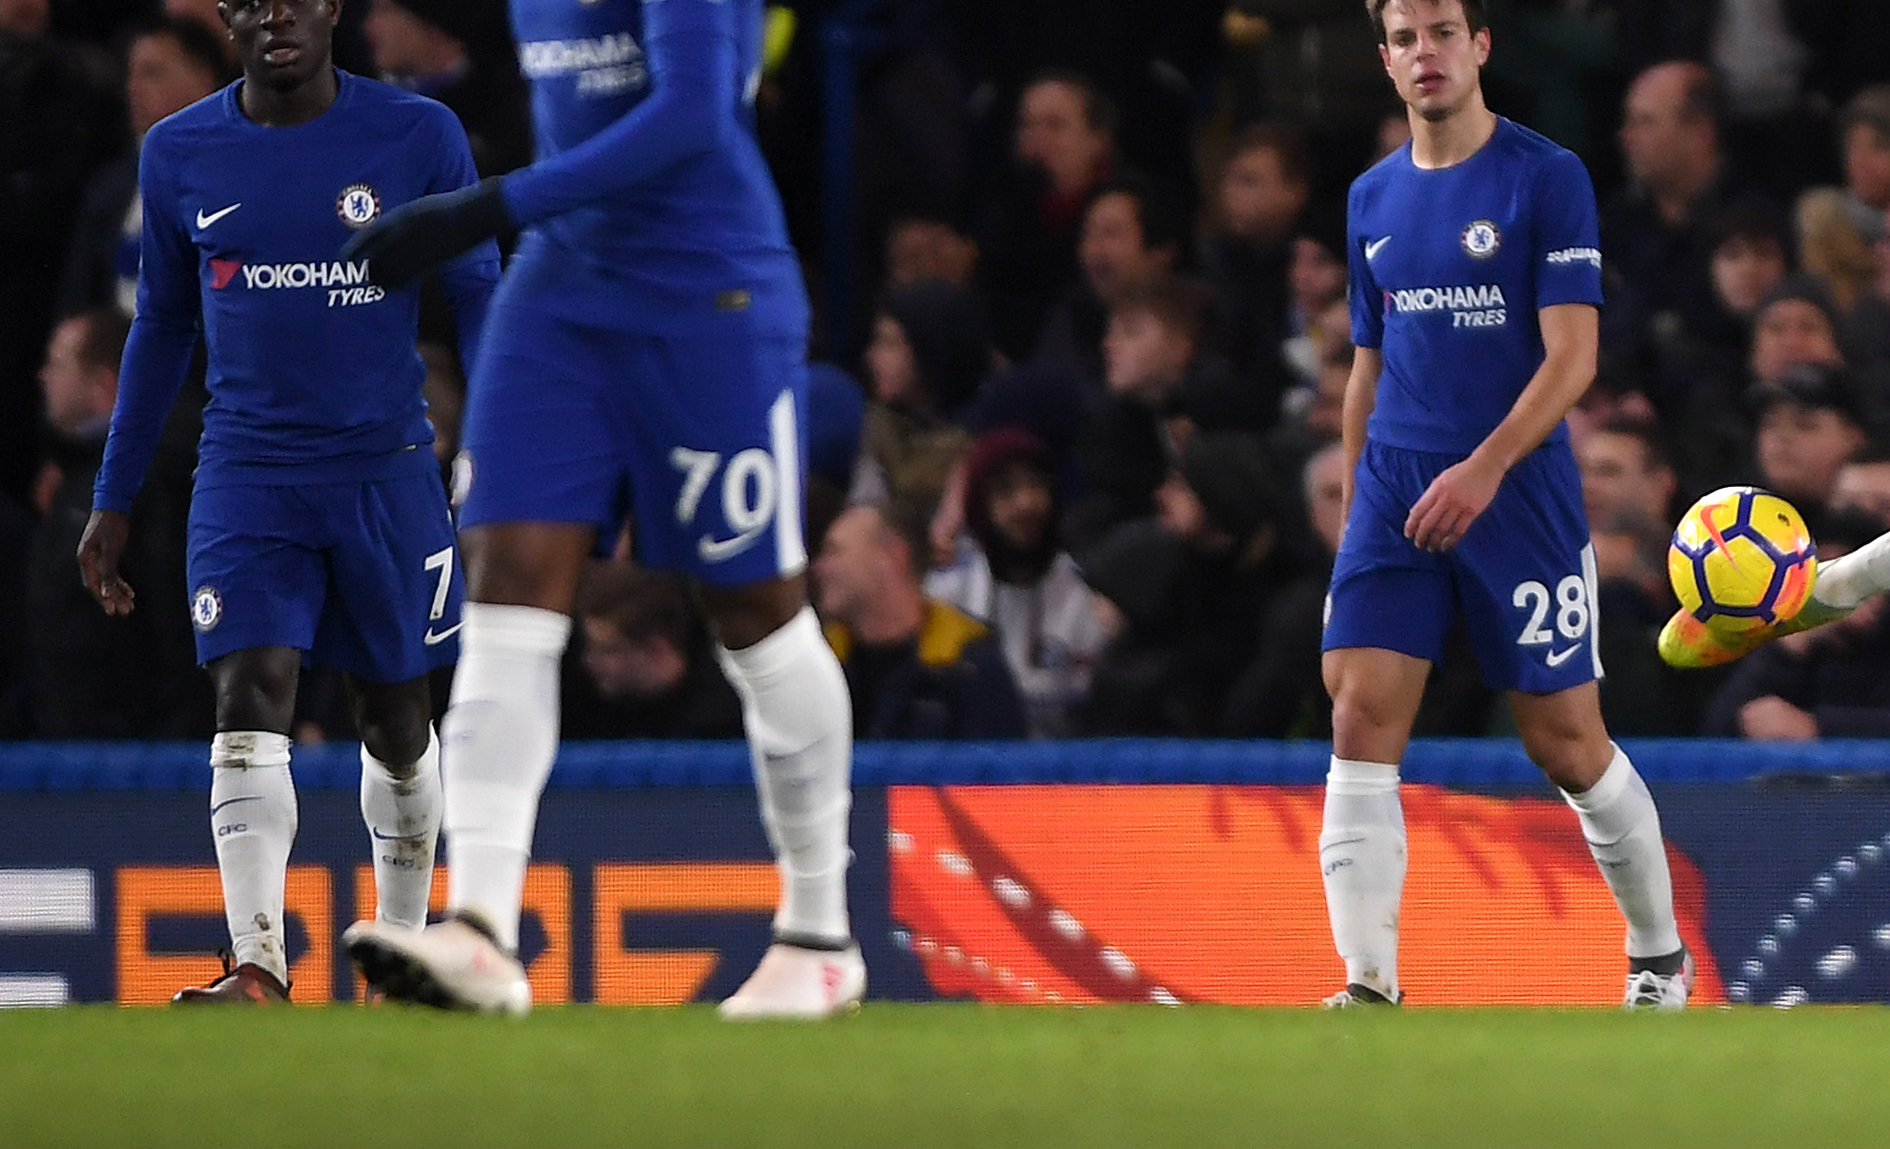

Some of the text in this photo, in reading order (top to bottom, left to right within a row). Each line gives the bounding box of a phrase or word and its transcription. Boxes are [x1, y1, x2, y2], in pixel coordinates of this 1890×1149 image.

[242, 258, 370, 290] YOKOHAM
[326, 285, 388, 308] TYRES
[1391, 283, 1507, 312] YOKOHAMA
[1452, 308, 1507, 328] TYRES
[670, 446, 774, 534] 70
[424, 545, 453, 621] 7
[1512, 574, 1589, 645] 28
[217, 822, 248, 837] CFC
